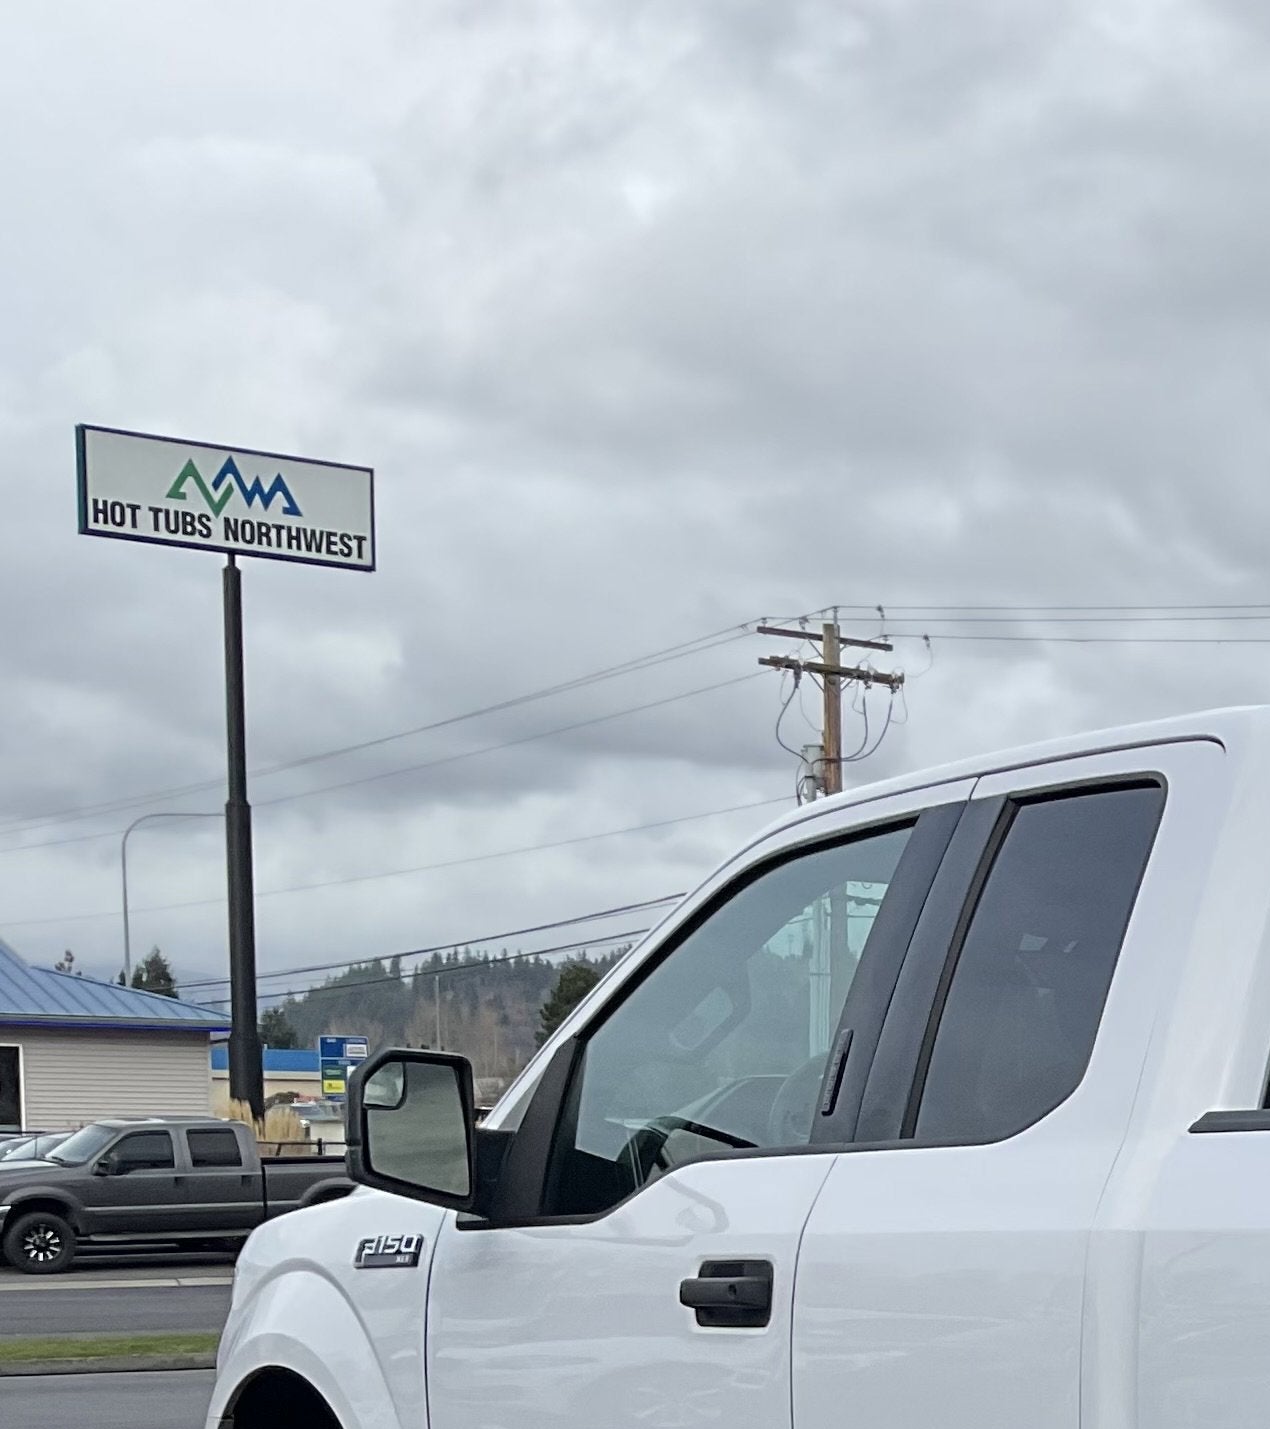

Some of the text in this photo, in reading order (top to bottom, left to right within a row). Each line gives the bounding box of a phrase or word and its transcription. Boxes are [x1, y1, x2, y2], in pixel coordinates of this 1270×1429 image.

[92, 499, 367, 560] HOT TUBS NORTHWEST
